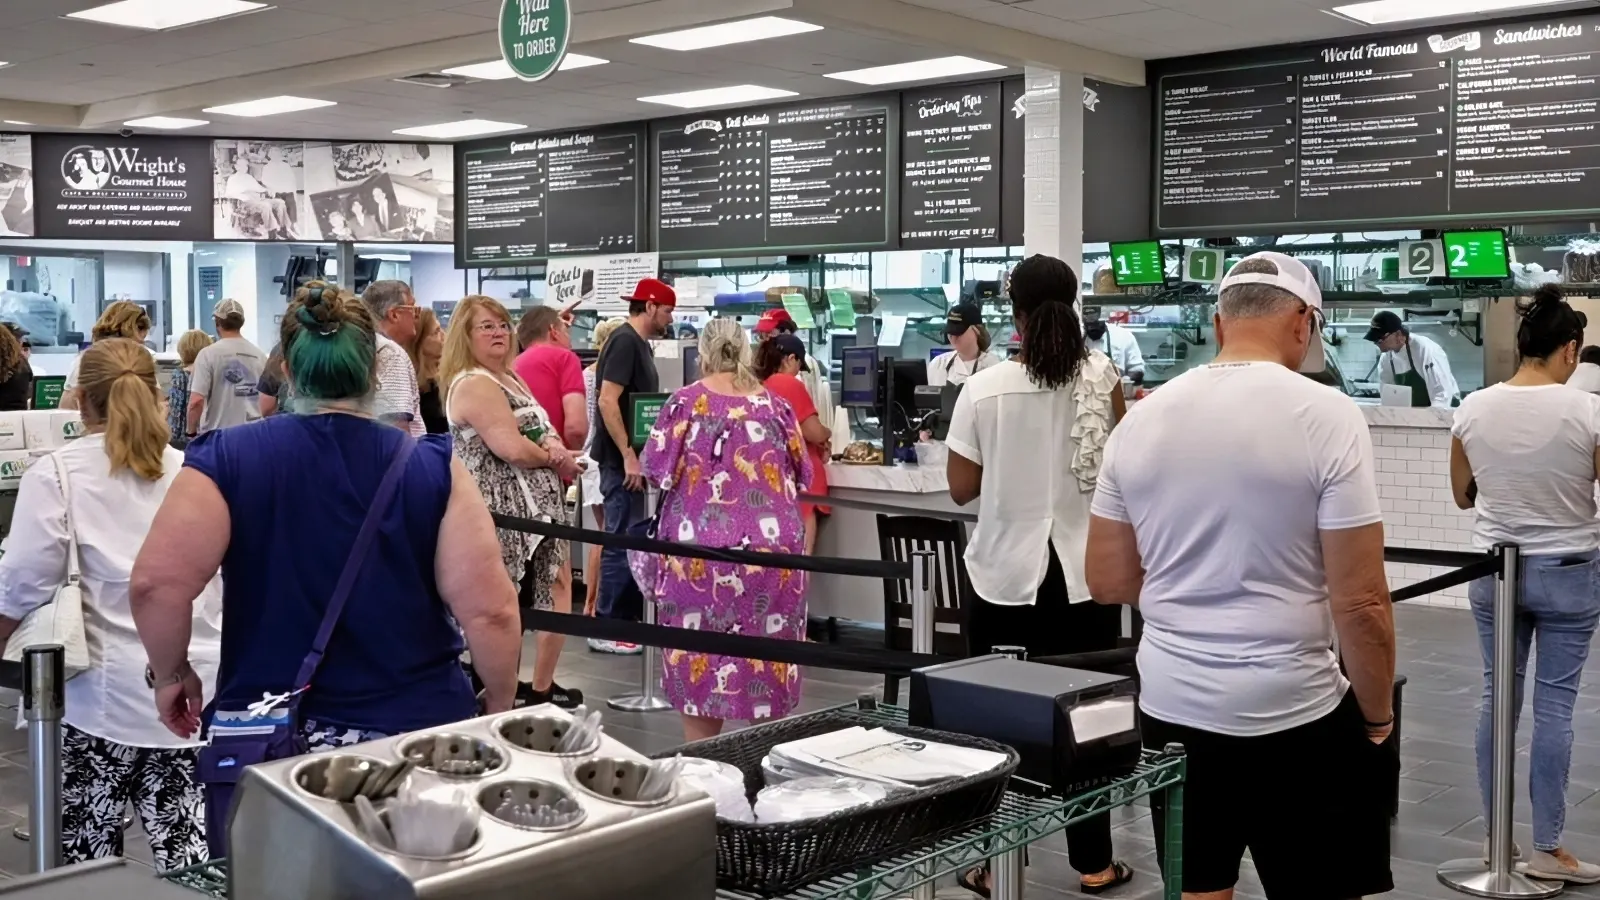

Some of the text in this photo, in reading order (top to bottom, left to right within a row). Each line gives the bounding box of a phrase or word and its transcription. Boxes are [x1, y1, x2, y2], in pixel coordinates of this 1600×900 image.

[518, 13, 549, 36] Here
[1494, 23, 1582, 45] Sandwiches
[513, 36, 556, 59] TO ORDER
[1321, 42, 1418, 63] World Famous
[1355, 69, 1373, 77] SALAD
[918, 94, 982, 119] Ordering Tips
[742, 113, 770, 127] Salads
[510, 134, 594, 154] Gourmet Salads and Soups
[105, 147, 186, 176] Wright's
[111, 175, 187, 187] Gourmet House
[1116, 254, 1131, 275] 1
[1198, 255, 1207, 277] 1
[1412, 247, 1431, 271] 2
[1449, 244, 1469, 267] 2
[548, 269, 571, 287] Cake
